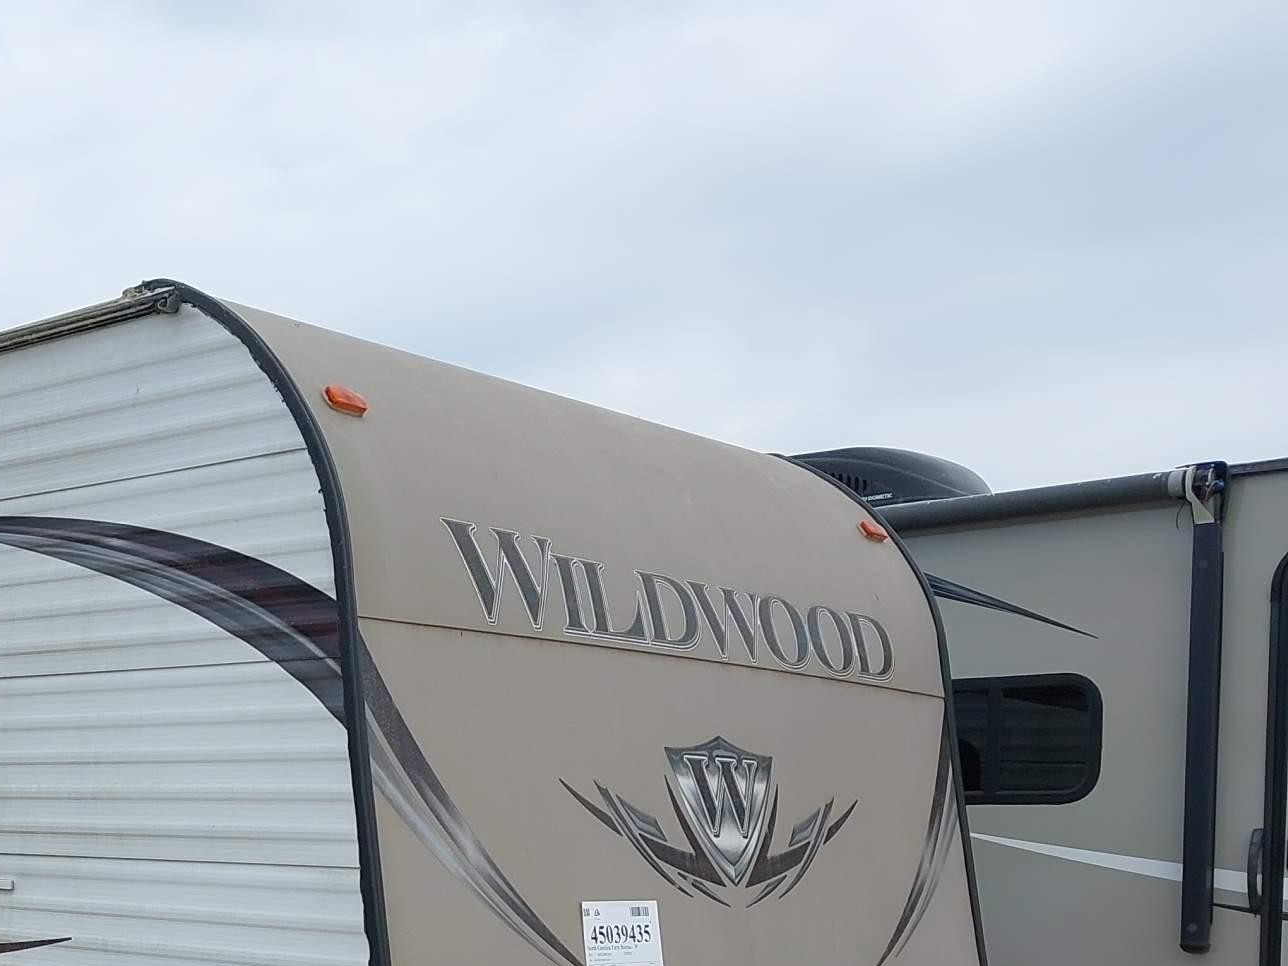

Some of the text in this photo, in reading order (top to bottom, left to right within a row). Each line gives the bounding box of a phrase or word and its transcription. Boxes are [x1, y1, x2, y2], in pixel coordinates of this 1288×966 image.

[440, 517, 896, 682] WILDWOOD
[683, 753, 759, 838] W
[591, 924, 651, 944] 45039435
